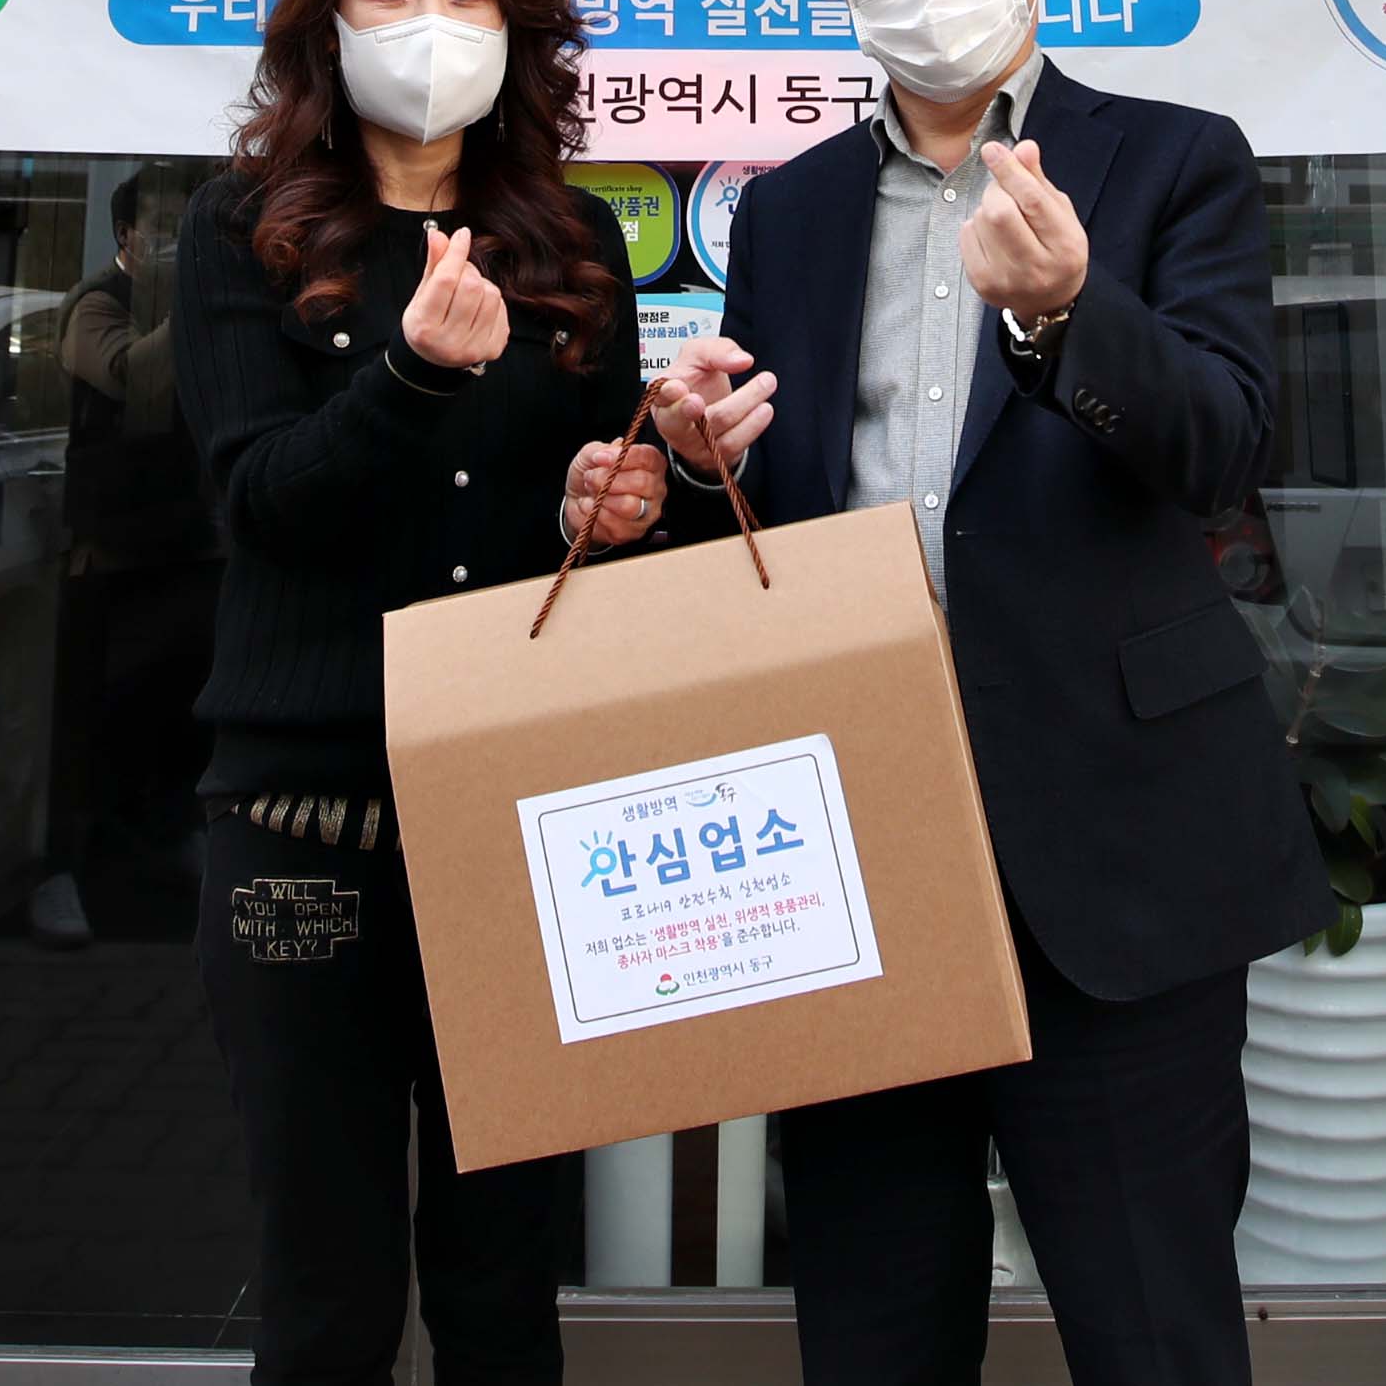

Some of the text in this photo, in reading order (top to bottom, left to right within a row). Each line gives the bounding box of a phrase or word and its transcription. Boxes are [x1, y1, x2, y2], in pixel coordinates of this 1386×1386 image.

[622, 795, 679, 822] 생활방역
[581, 809, 805, 898] 안심업소
[269, 883, 317, 900] WILL
[620, 872, 792, 921] 코로나19 안전수칙 실천업소
[244, 900, 343, 917] YOU OPEN
[237, 917, 352, 937] WITH WHICH
[585, 937, 609, 956] 저희
[612, 931, 647, 951] 업소는
[735, 903, 771, 925] 위생적
[267, 939, 318, 958] KEY?
[617, 950, 653, 971] 종사자
[655, 941, 692, 960] 마스크
[737, 917, 801, 944] 준수합니다.
[682, 954, 774, 987] 인천광역시 동구
